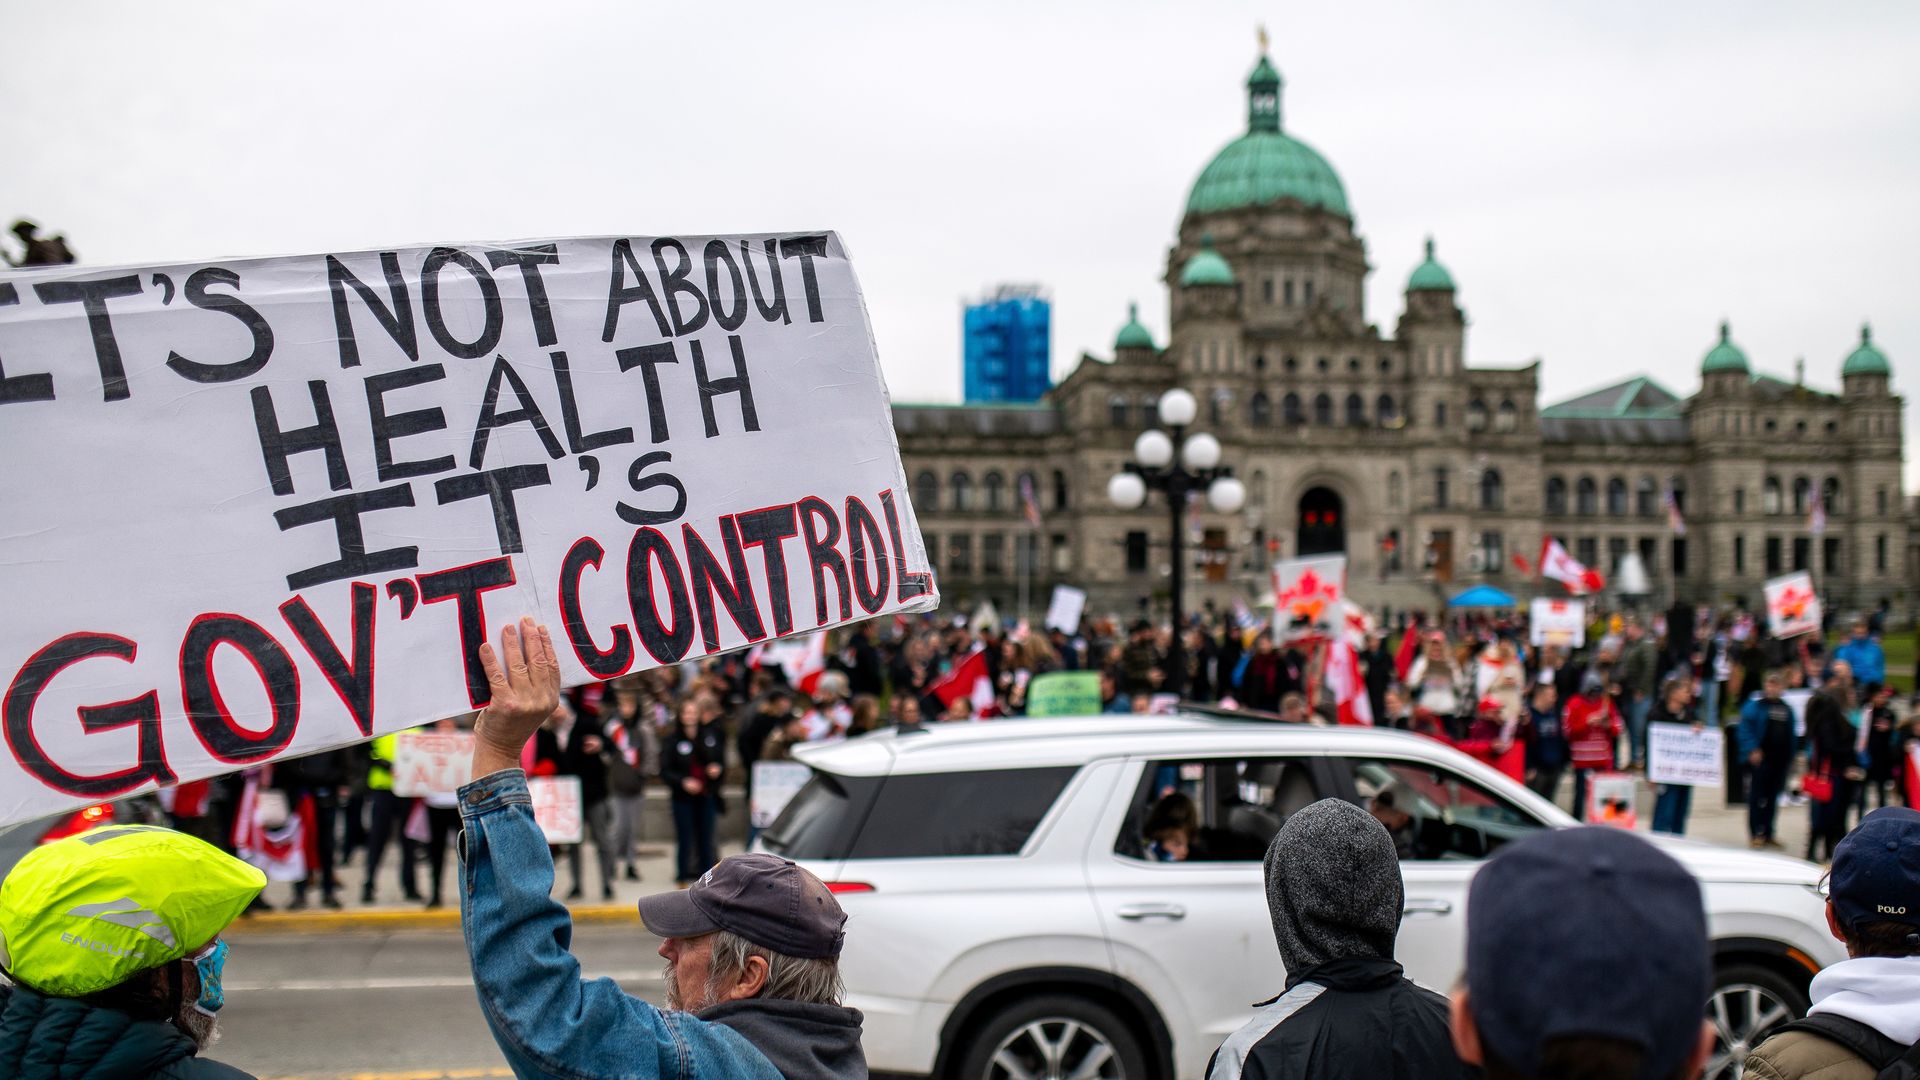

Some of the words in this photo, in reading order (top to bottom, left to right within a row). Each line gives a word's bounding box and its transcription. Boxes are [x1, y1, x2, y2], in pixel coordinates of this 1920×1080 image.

[326, 244, 559, 369] NOT
[602, 235, 828, 343] ABOUT
[250, 335, 761, 495] HEALTH
[273, 451, 687, 591] IT'S
[2, 556, 517, 799] GOV'T
[559, 488, 934, 680] CONTROL
[1877, 904, 1906, 914] POLO
